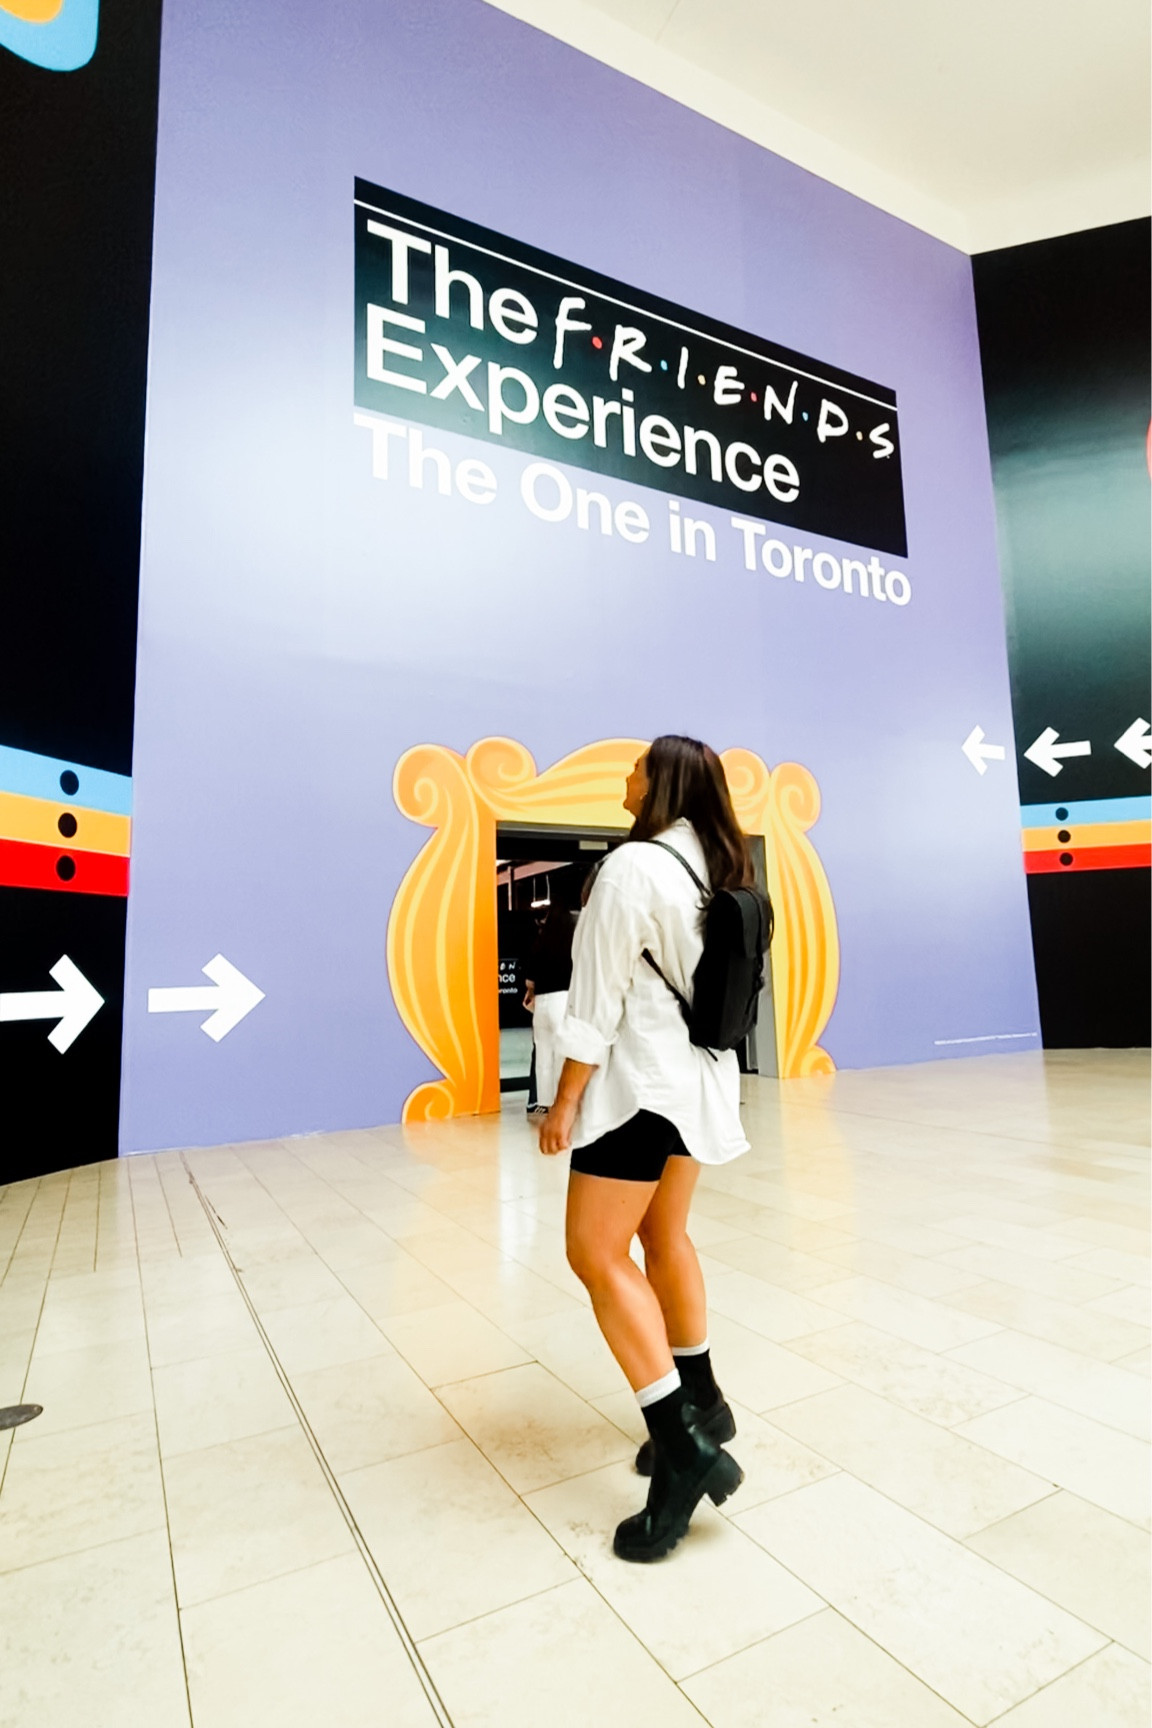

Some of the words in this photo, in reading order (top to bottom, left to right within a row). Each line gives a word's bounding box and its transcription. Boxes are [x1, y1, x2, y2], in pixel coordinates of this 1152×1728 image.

[366, 218, 538, 344] The
[366, 302, 801, 503] Experience
[353, 411, 498, 505] The
[520, 461, 650, 544] One
[668, 500, 716, 561] in
[731, 516, 912, 606] Toronto
